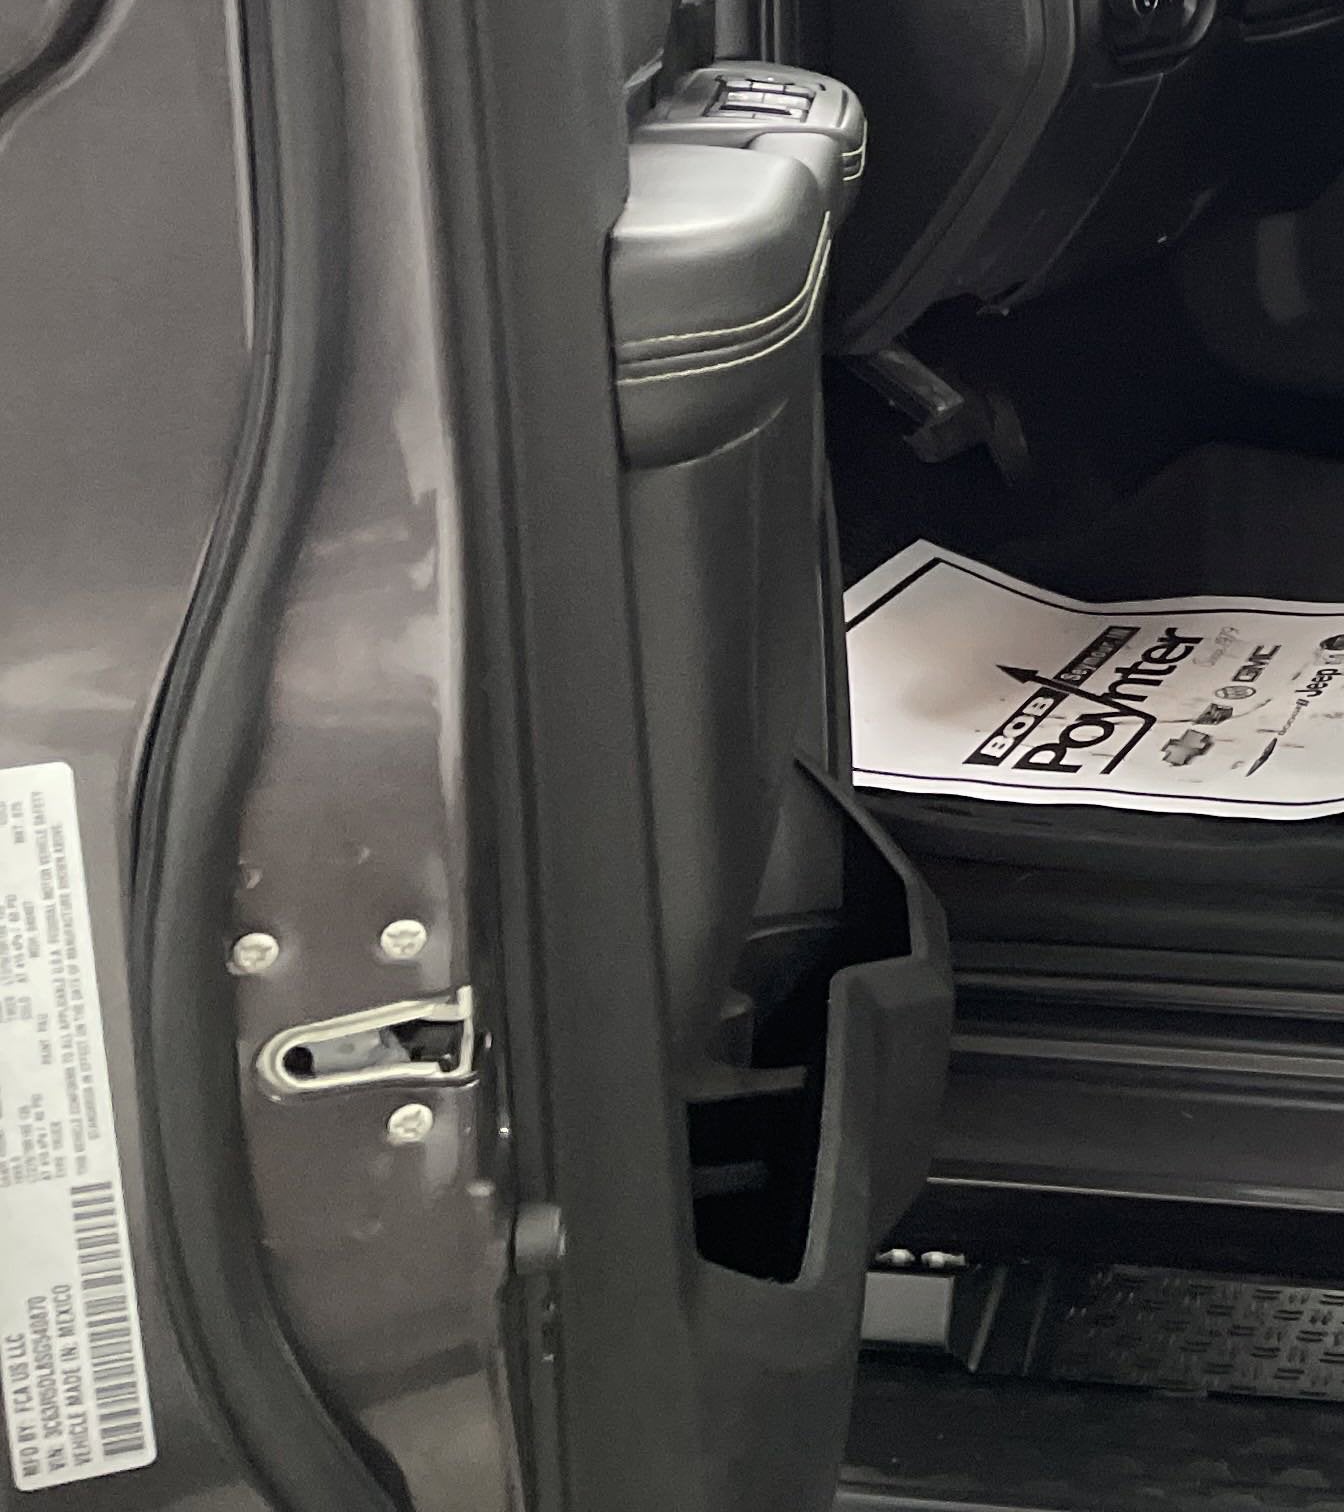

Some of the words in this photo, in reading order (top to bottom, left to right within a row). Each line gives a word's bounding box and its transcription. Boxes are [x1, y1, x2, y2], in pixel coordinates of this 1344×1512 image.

[1232, 645, 1282, 682] GMC
[1011, 627, 1204, 773] Poynter
[1295, 668, 1344, 698] Jeep
[981, 696, 1055, 758] BOB
[51, 1284, 76, 1338] MEXICO
[5, 1332, 27, 1359] LLC
[8, 1361, 29, 1383] US
[61, 1367, 84, 1407] MADE
[13, 1386, 34, 1413] FCA
[67, 1411, 92, 1466] VEHICLE
